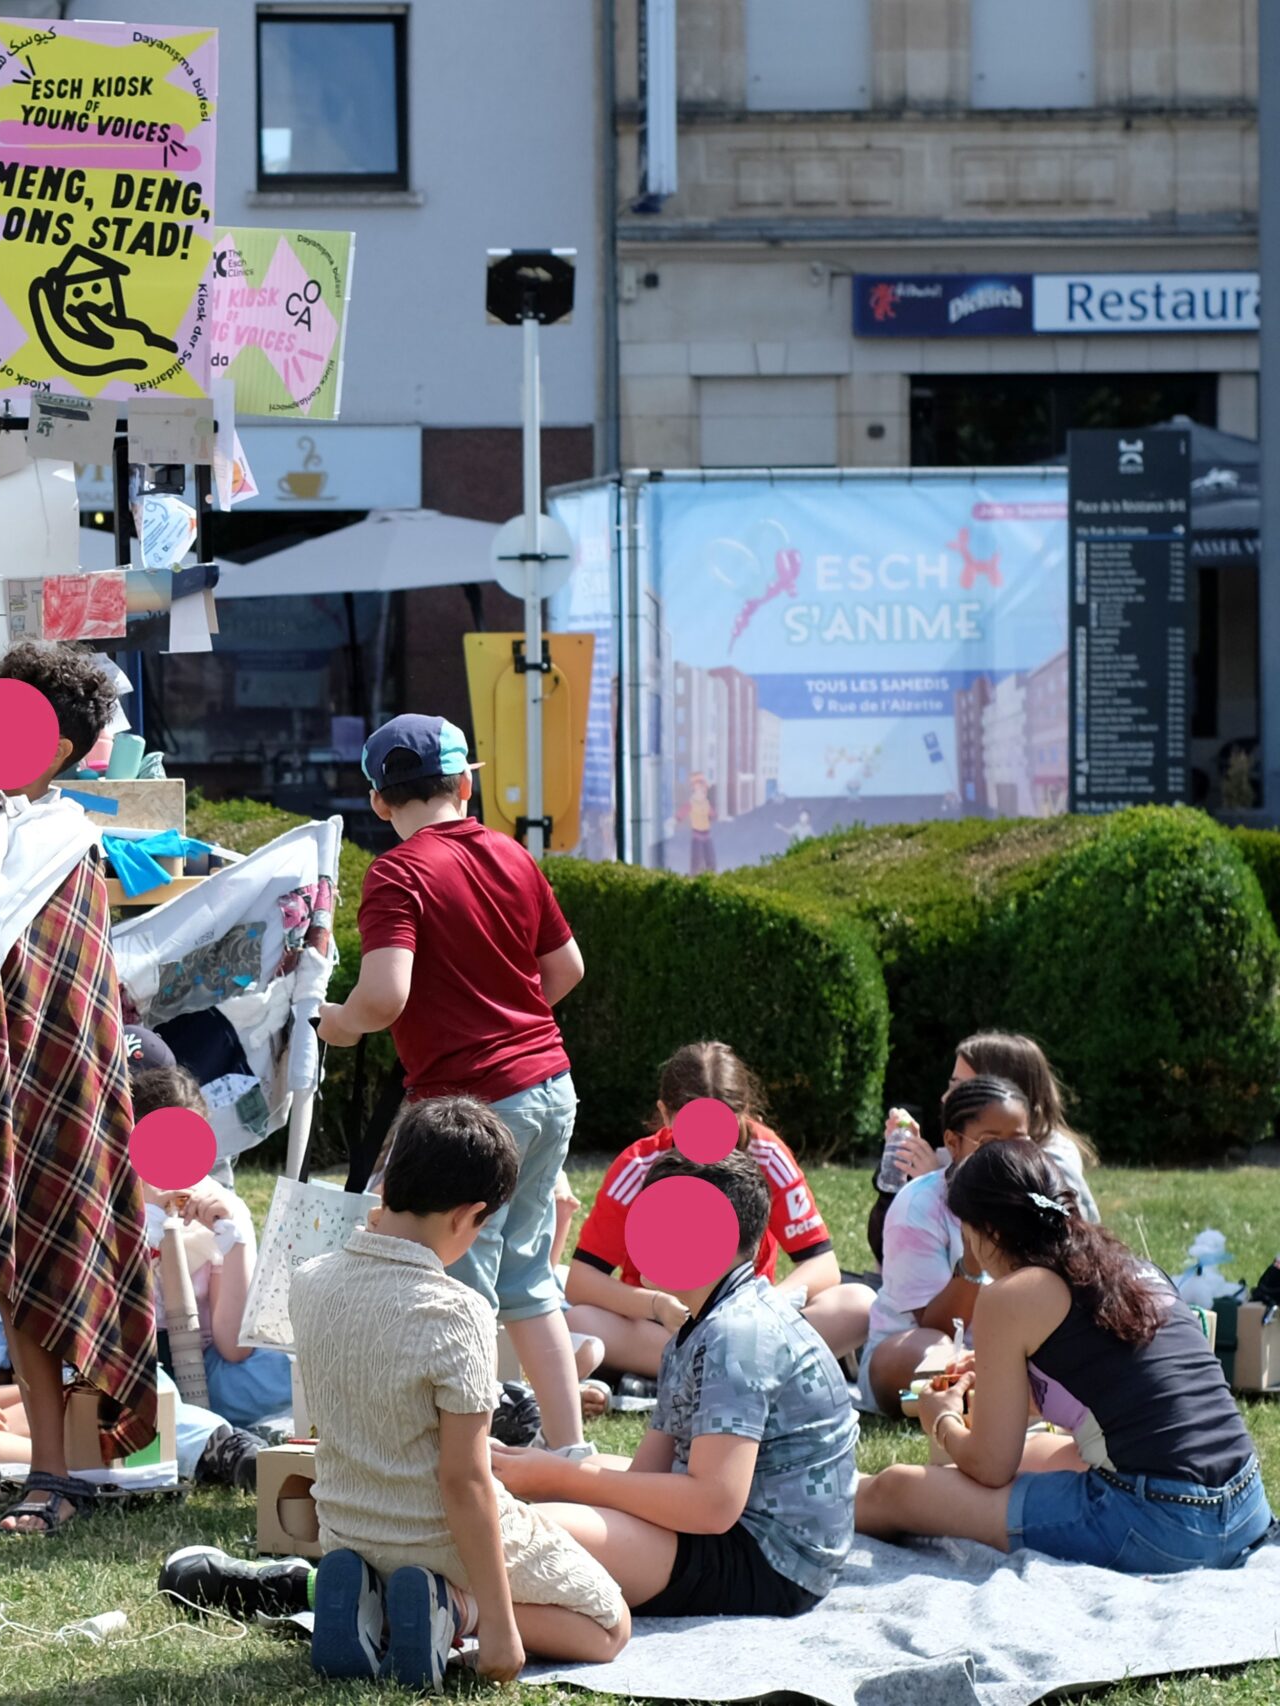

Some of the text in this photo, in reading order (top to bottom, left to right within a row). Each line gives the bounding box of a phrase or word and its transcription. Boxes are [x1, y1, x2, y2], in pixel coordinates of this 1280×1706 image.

[31, 76, 154, 100] ESCH KIOSK
[132, 31, 212, 122] Dayanışma büfesi
[85, 100, 101, 113] OF
[21, 105, 171, 143] YOUNG VOICES
[111, 173, 211, 223] DENG,
[2, 207, 194, 260] ONS STAD!
[228, 259, 247, 267] Esch
[227, 287, 280, 308] KIOSK
[226, 311, 240, 322] OF
[135, 283, 208, 393] Kiosk der Solidarität
[233, 326, 297, 353] VOICES
[15, 375, 51, 392] Kiosk
[816, 553, 949, 592] ESCH
[784, 602, 982, 643] S'ANIME
[805, 677, 949, 694] TOUS LES SAMEDIS
[827, 699, 853, 713] Rue
[856, 698, 872, 713] de
